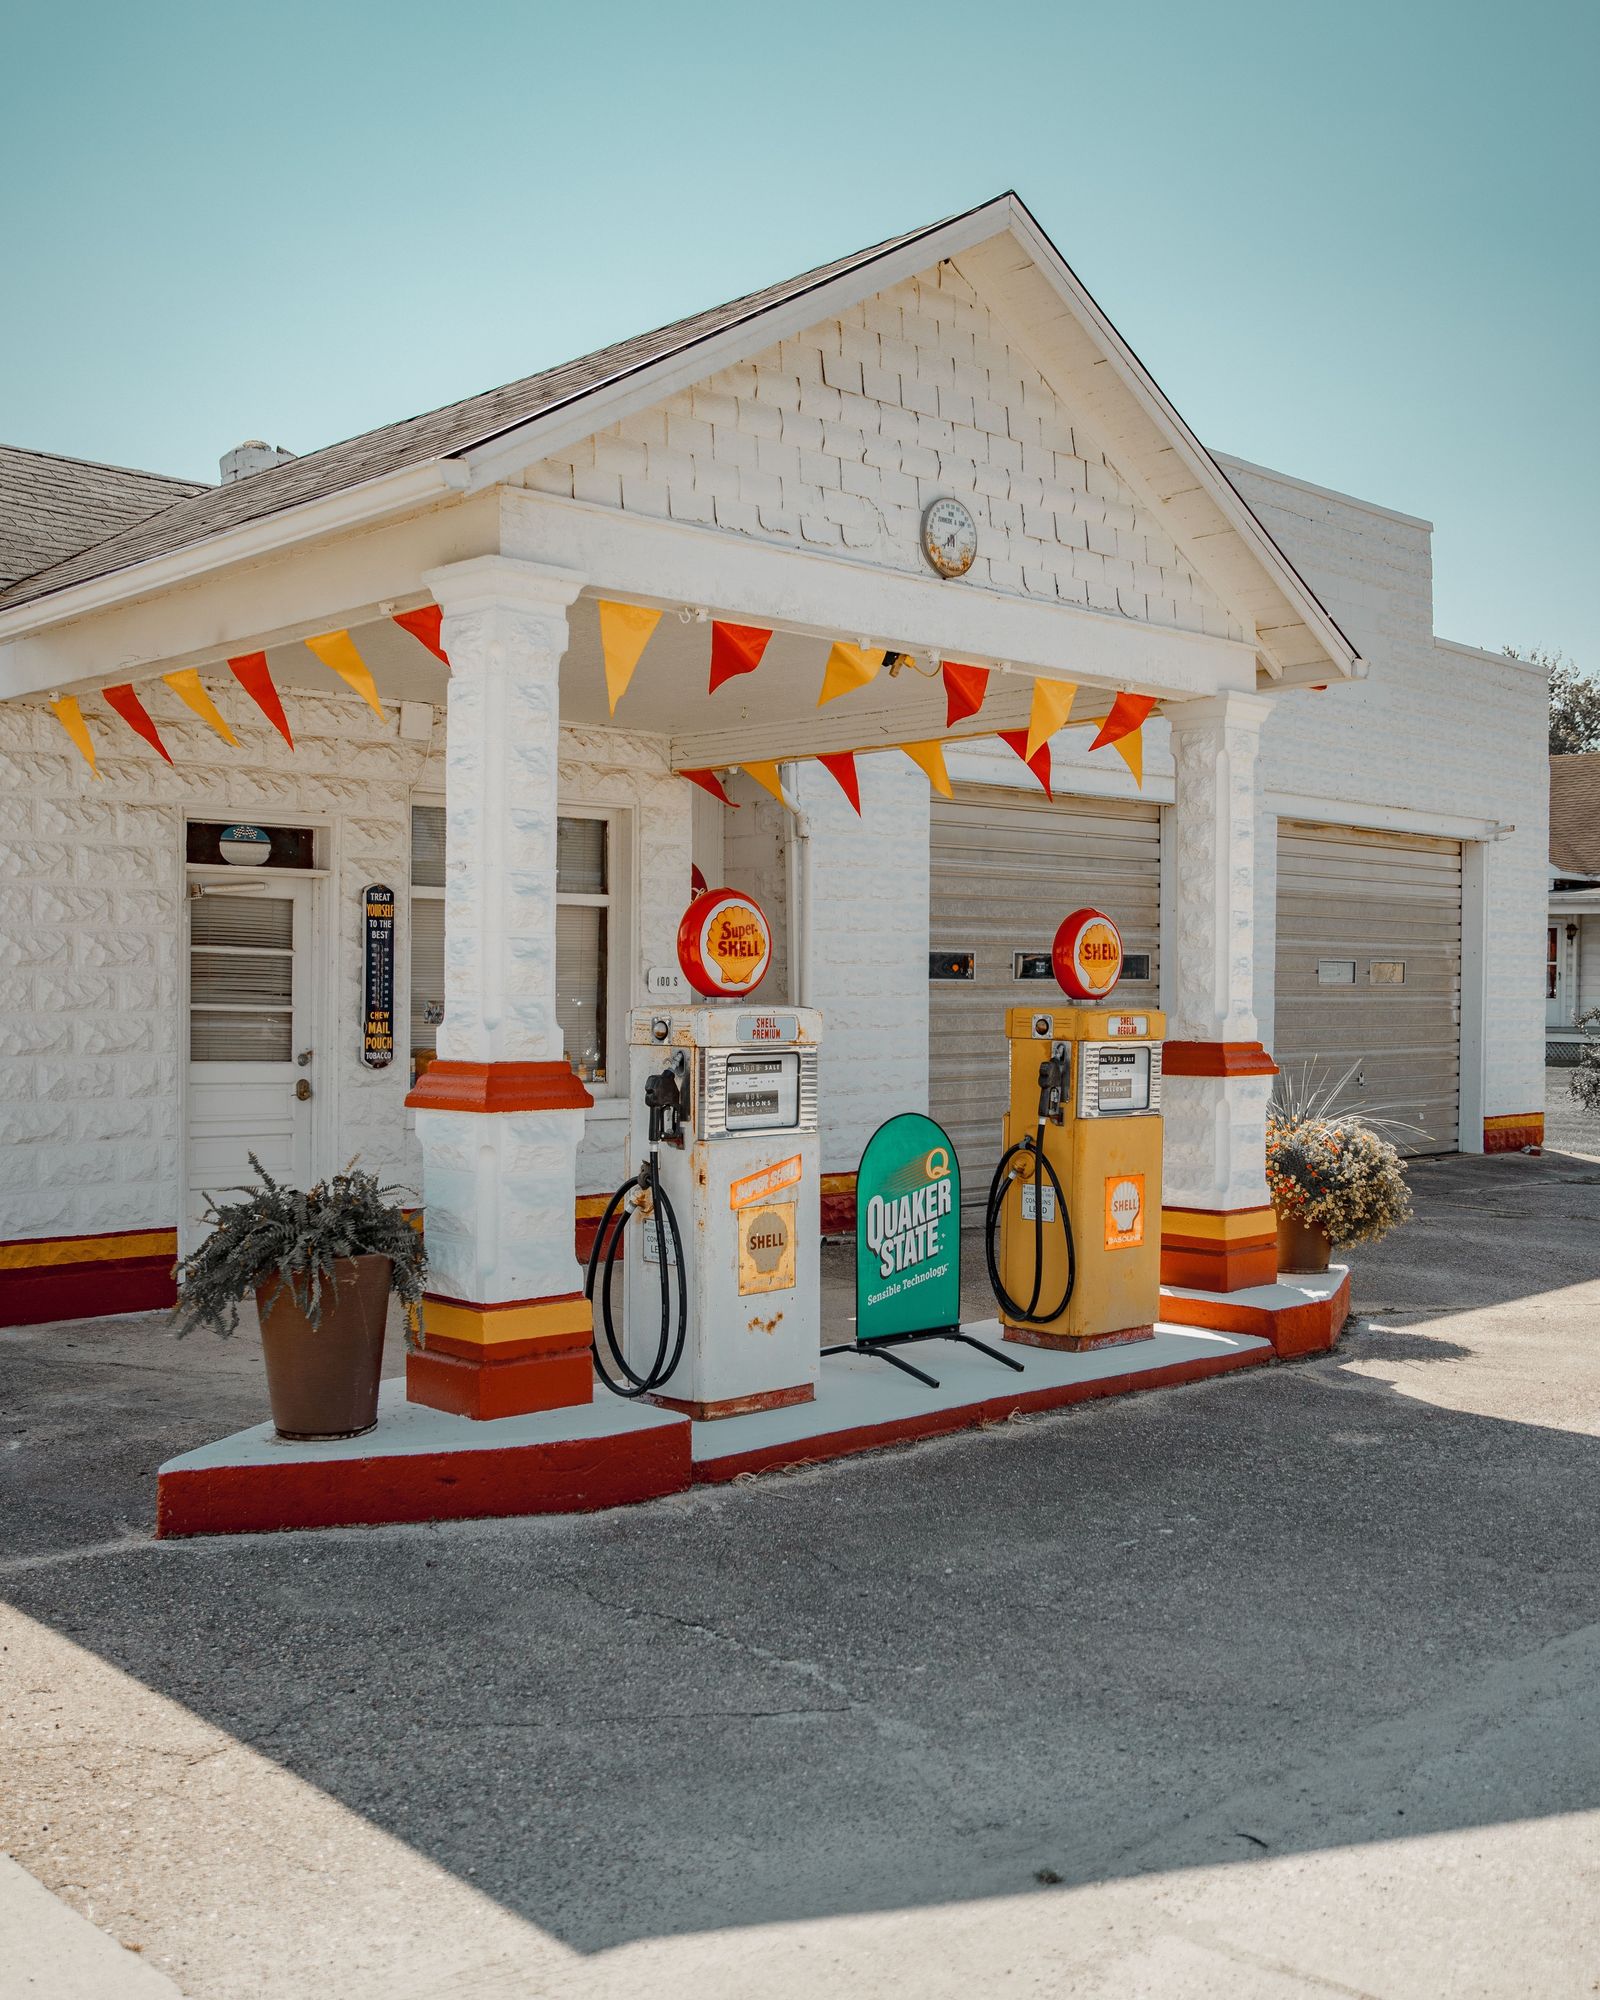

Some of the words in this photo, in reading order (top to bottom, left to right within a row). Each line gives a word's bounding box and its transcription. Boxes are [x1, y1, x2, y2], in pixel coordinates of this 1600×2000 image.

[370, 892, 390, 901] TREAT
[367, 904, 394, 917] YOURSELF
[369, 919, 378, 928] TO
[379, 919, 392, 928] THE
[371, 930, 389, 939] BEST
[718, 940, 760, 957] SHELL
[1084, 943, 1118, 960] SHELL
[370, 1011, 390, 1020] CHEW
[1120, 1016, 1135, 1026] SHELL
[368, 1021, 391, 1034] MAIL
[756, 1017, 776, 1028] SHELL
[752, 1029, 781, 1040] PREMIUM
[1117, 1026, 1137, 1035] REGULAR
[365, 1036, 392, 1050] POUCH
[365, 1051, 391, 1060] TOBACCO
[735, 1100, 771, 1108] GALLONS
[925, 1147, 951, 1180] Q
[1029, 1206, 1047, 1214] LED
[1113, 1198, 1137, 1212] SHELL
[866, 1178, 952, 1257] QUAKER
[750, 1232, 784, 1250] SHELL
[867, 1283, 901, 1306] Sensible
